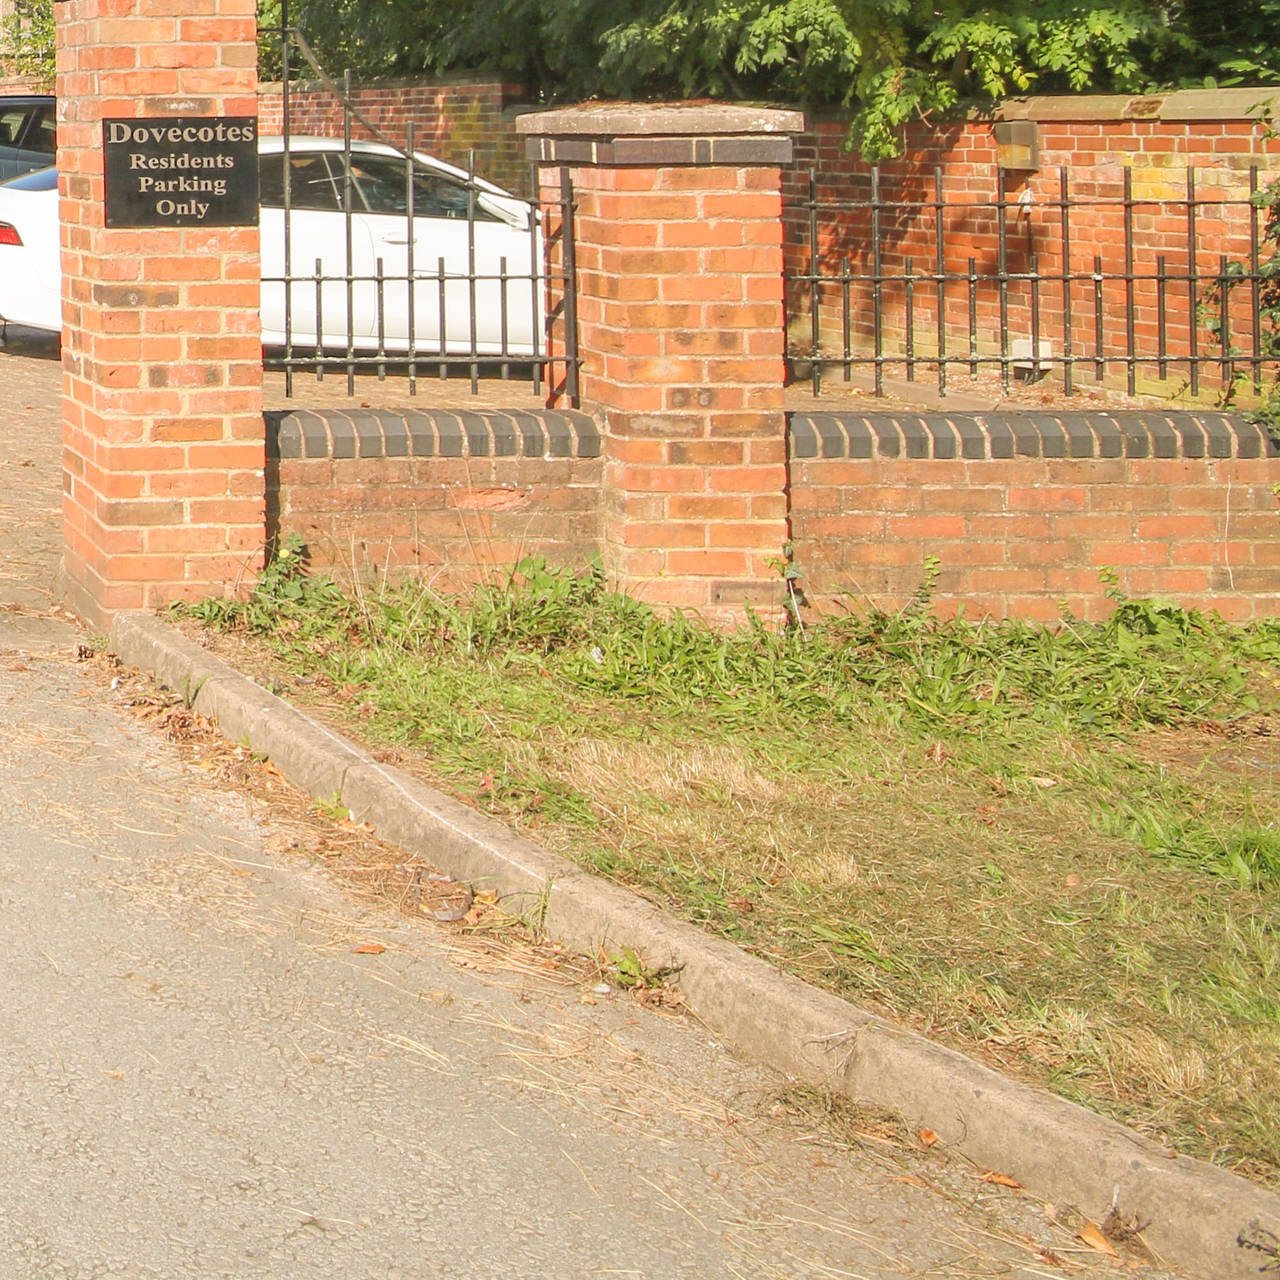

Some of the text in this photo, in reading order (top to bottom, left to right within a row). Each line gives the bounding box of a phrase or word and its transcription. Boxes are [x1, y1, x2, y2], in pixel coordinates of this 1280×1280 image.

[108, 122, 255, 144] Dovecotes
[129, 153, 235, 170] Residents
[138, 176, 227, 195] Parking
[156, 199, 210, 219] Only
